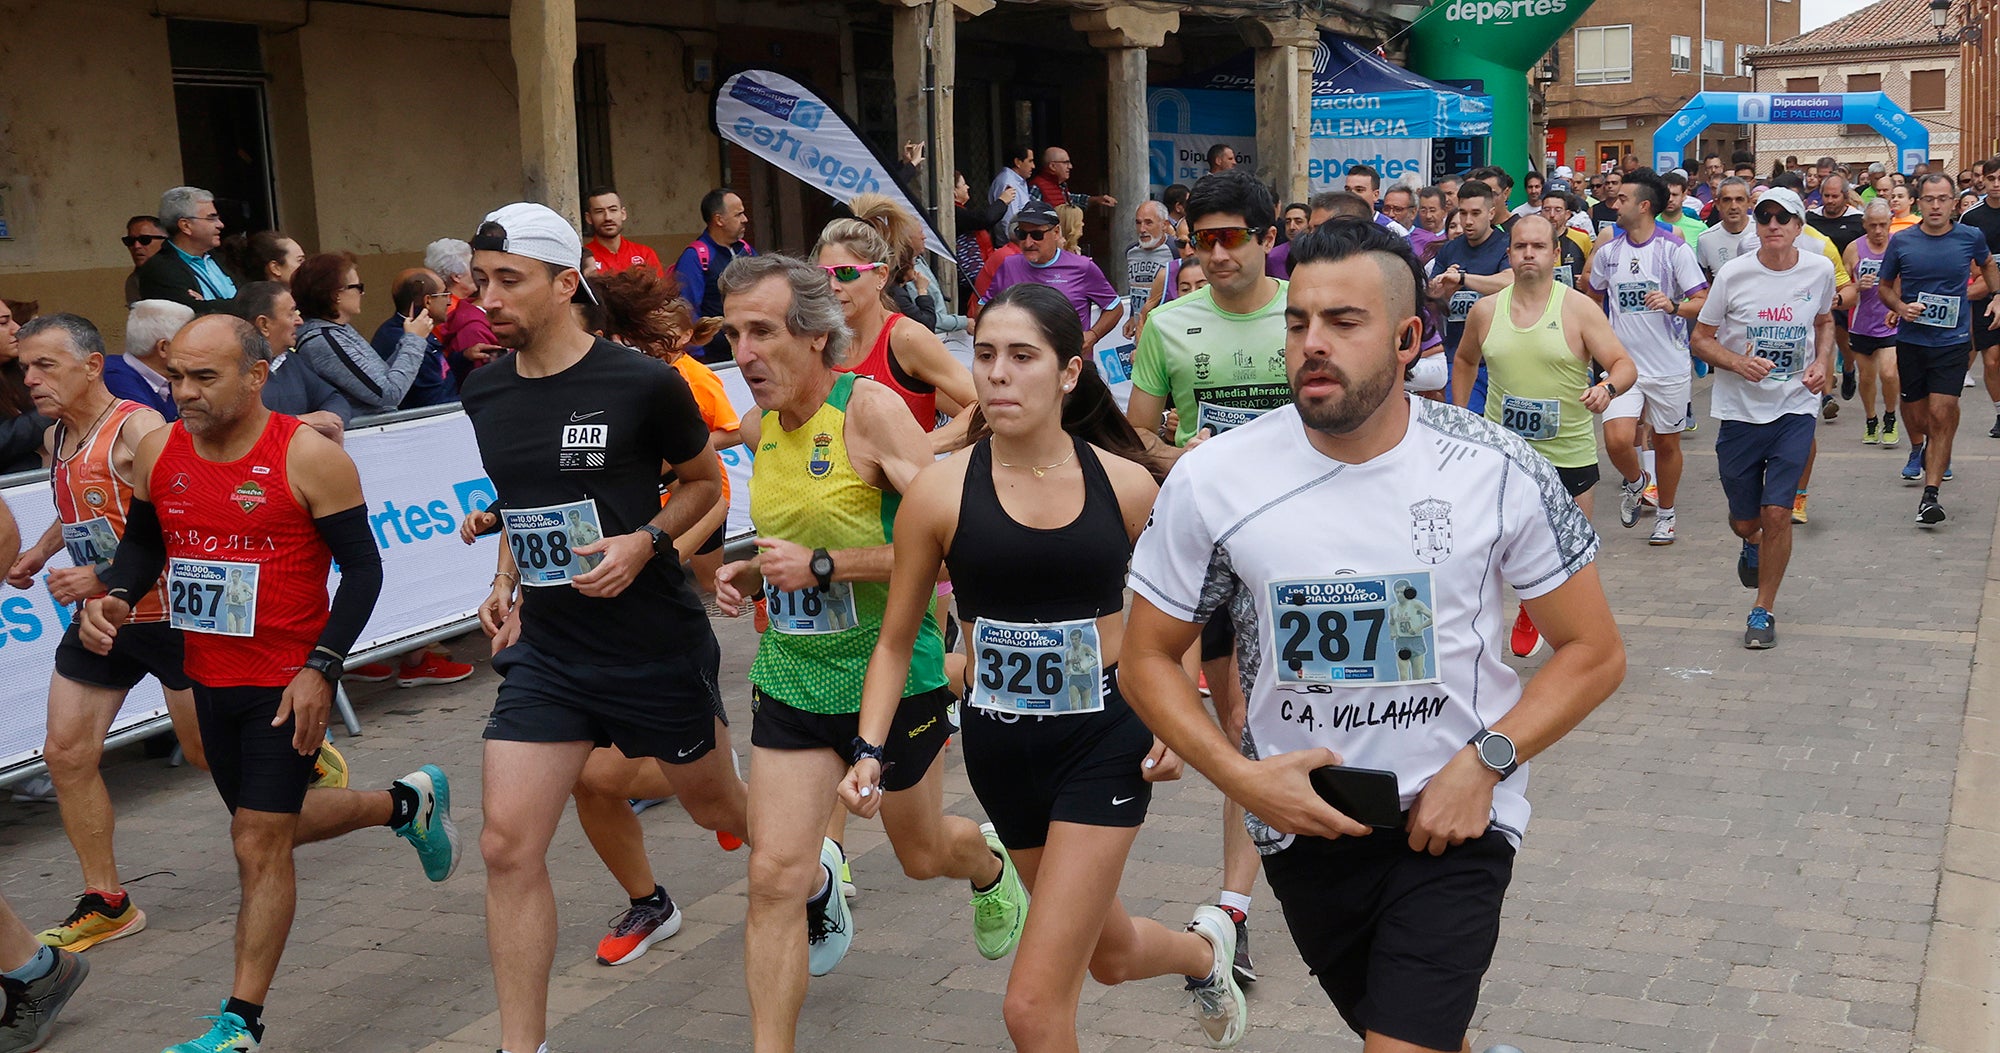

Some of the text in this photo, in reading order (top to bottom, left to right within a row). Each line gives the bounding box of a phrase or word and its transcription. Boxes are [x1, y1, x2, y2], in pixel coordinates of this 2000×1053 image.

[1446, 0, 1567, 25] deportes
[1773, 98, 1829, 109] Diputación
[1773, 110, 1841, 119] DE PALENCIA
[1310, 118, 1409, 137] ALENCIA
[1308, 154, 1420, 184] eportes
[1757, 303, 1793, 322] #MÁS
[1200, 391, 1213, 400] 38
[1215, 388, 1247, 399] Media
[1504, 409, 1541, 432] 208
[567, 427, 602, 444] BAR
[369, 500, 455, 550] rtes
[511, 530, 572, 570] 288
[171, 580, 225, 618] 267
[1304, 583, 1356, 596] 10.000
[1343, 592, 1379, 604] HARO
[999, 628, 1040, 641] 10.000
[1029, 637, 1057, 647] HARO
[1279, 608, 1387, 663] 287
[980, 648, 1064, 695] 326
[1333, 694, 1449, 732] VILLAHAN
